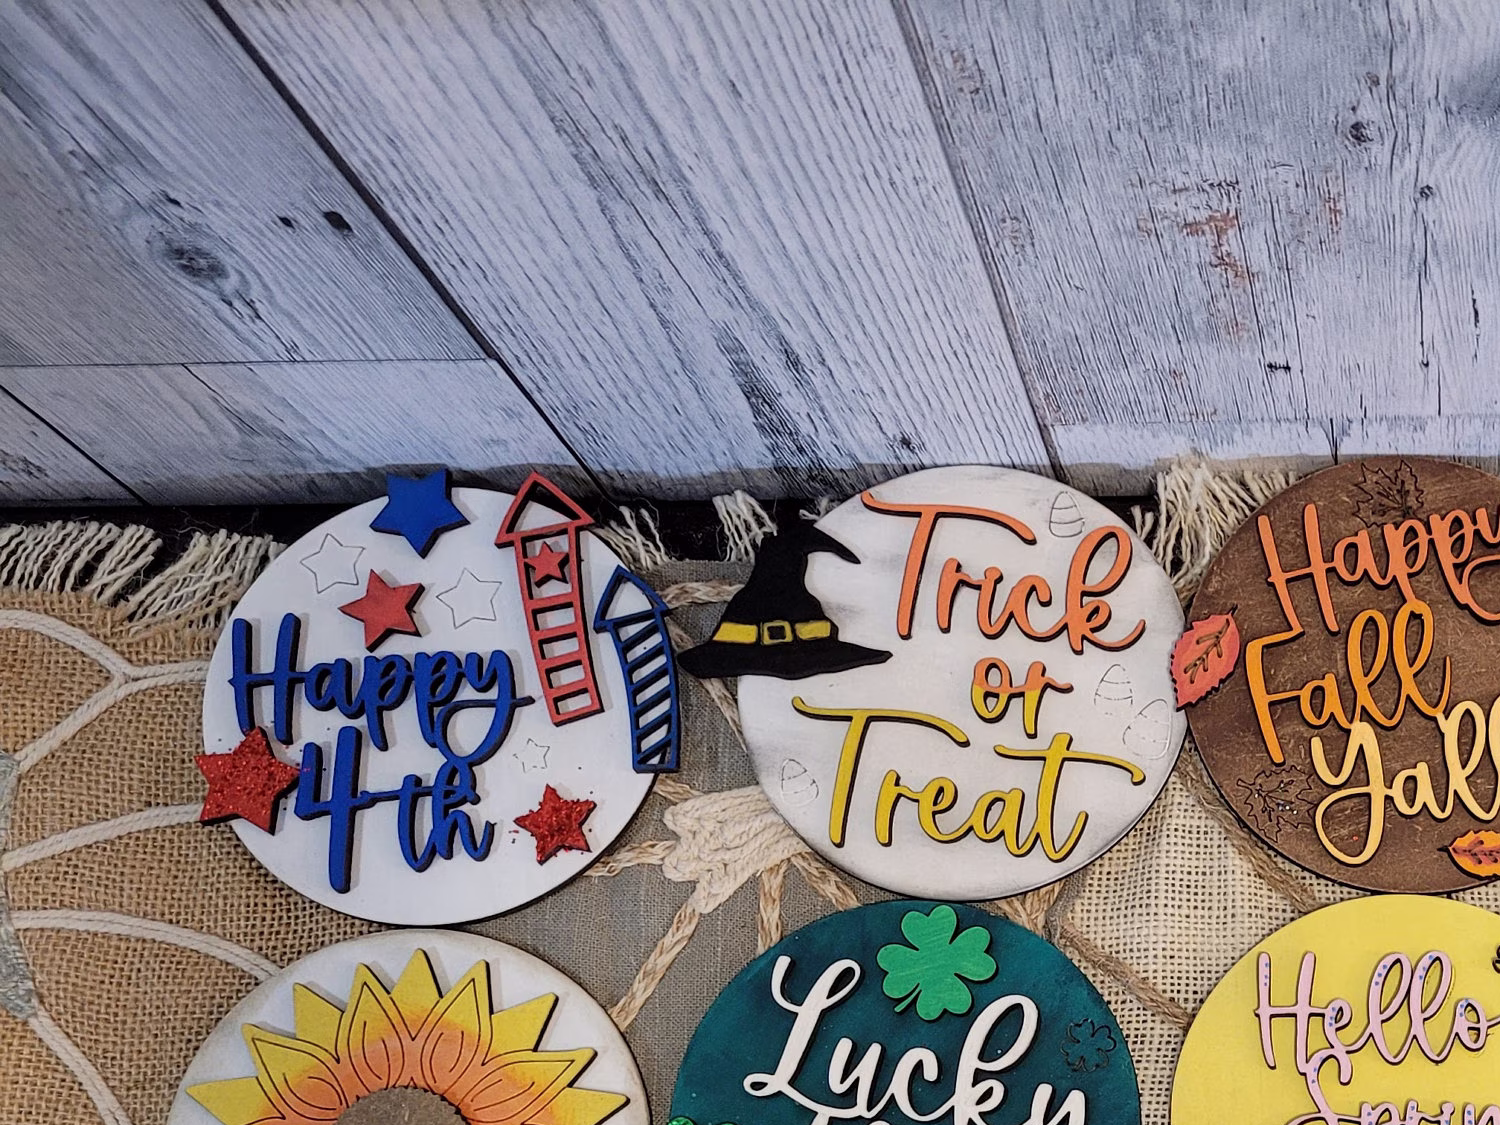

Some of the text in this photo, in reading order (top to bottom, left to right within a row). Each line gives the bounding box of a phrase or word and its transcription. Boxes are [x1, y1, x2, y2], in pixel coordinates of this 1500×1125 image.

[860, 491, 1146, 655] Trick
[228, 612, 536, 769] Happy
[971, 657, 1074, 738] or
[1245, 600, 1453, 766] Fall
[294, 726, 497, 893] 4th
[791, 696, 1146, 863] Treat
